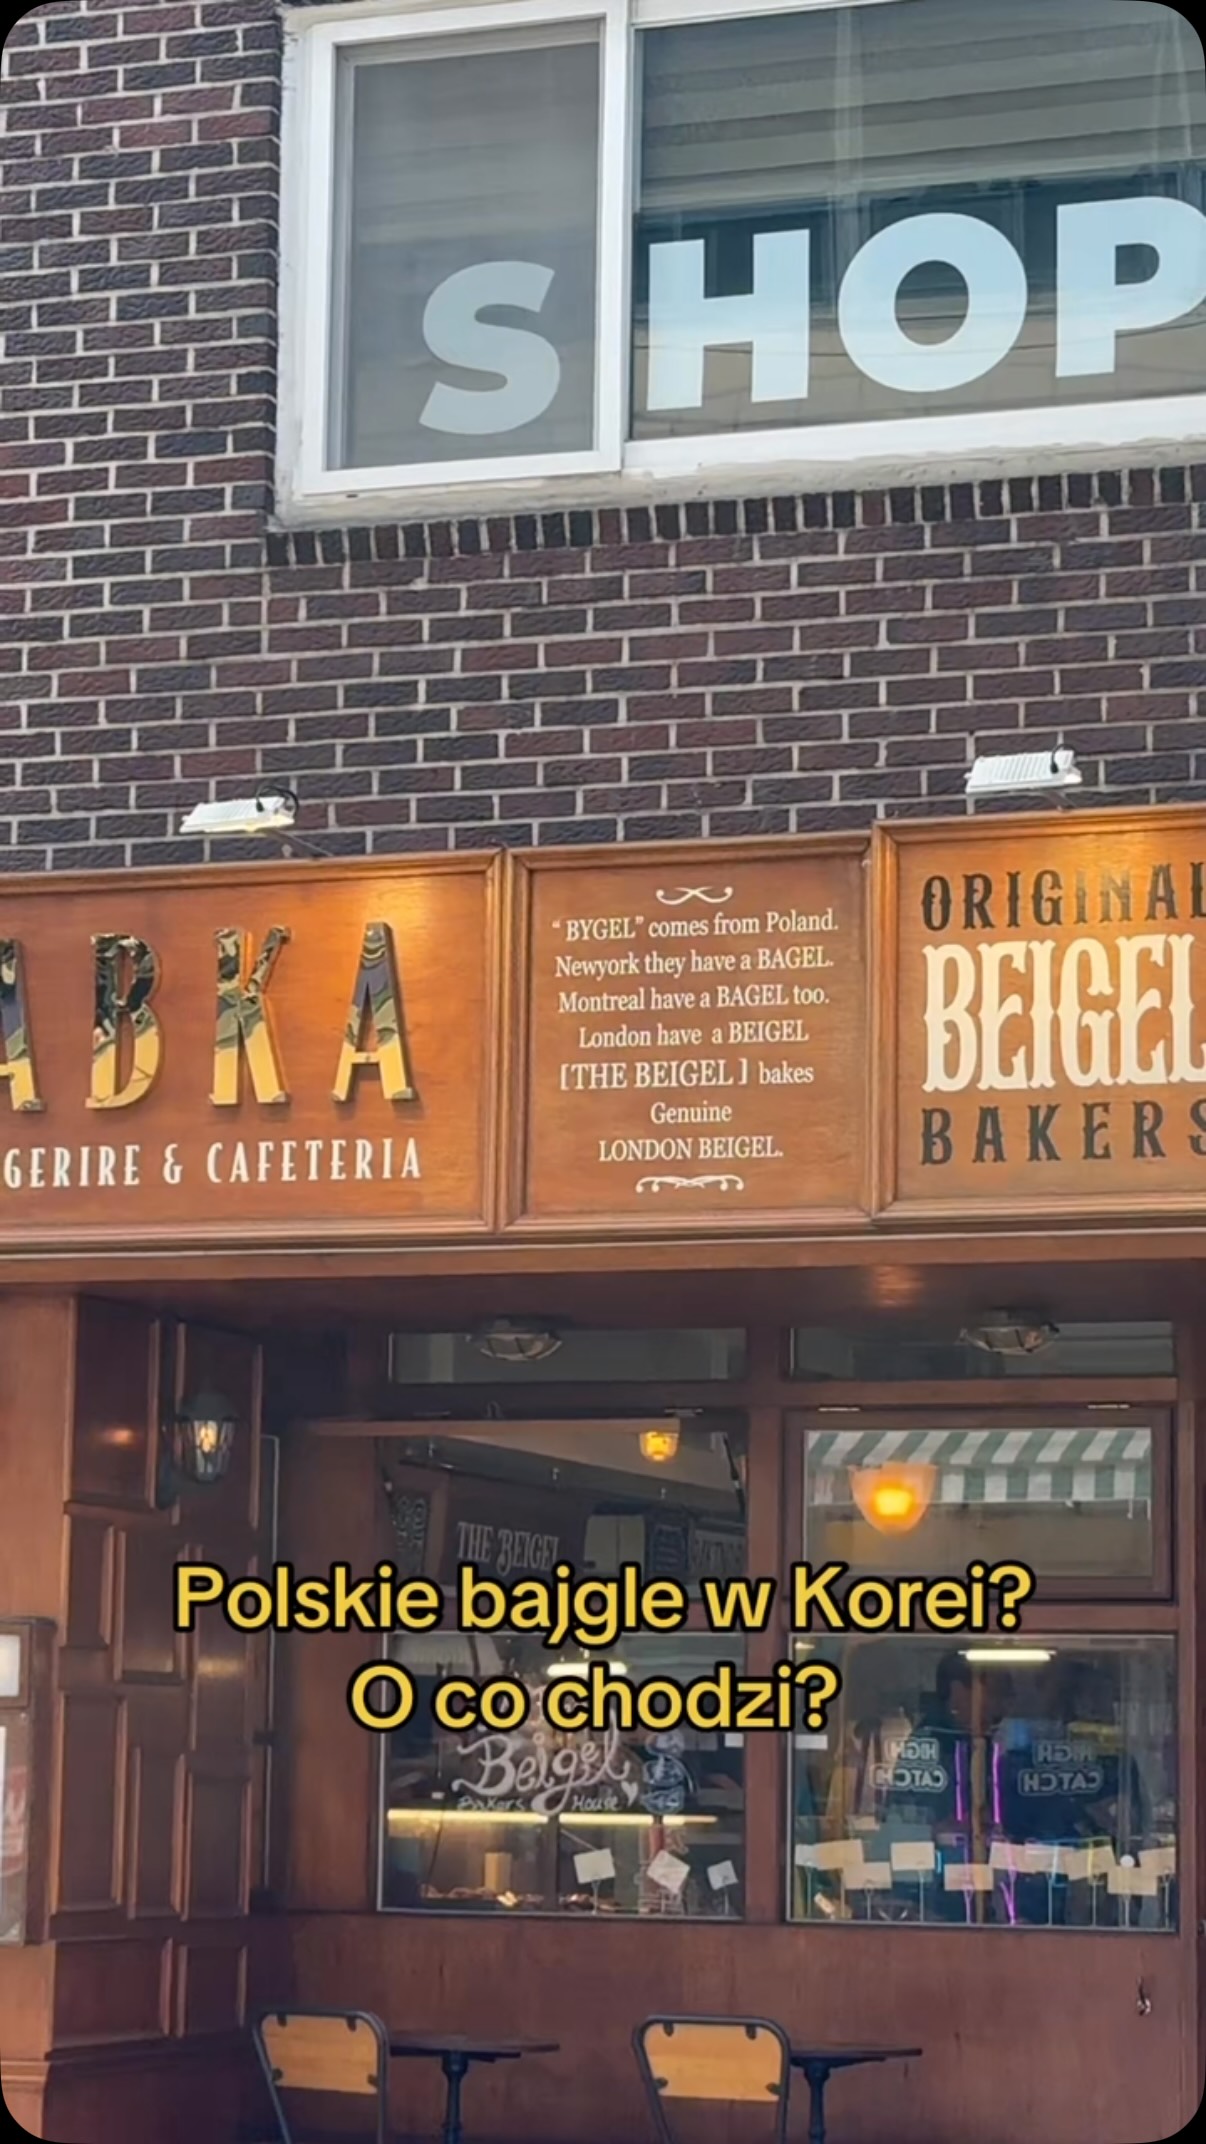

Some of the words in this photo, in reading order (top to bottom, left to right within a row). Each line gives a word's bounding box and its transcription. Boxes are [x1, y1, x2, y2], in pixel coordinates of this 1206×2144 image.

[419, 196, 1206, 435] SHOP
[921, 862, 1206, 931] ORIGINAL
[648, 918, 708, 938] comes
[713, 912, 760, 935] from
[766, 908, 838, 933] Poland.
[555, 953, 639, 981] Newyork
[644, 951, 685, 978] they
[691, 950, 736, 972] have
[740, 953, 751, 970] a
[758, 946, 833, 969] BAGEL.
[558, 988, 645, 1013] Montreal
[651, 988, 695, 1010] have
[700, 991, 711, 1007] a
[716, 985, 788, 1007] BAGEL
[793, 986, 829, 1005] too.
[921, 933, 1206, 1093] BEIGEL
[579, 1025, 650, 1048] London
[657, 1024, 701, 1046] have
[712, 1028, 722, 1043] a
[728, 1020, 809, 1043] BEIGEL
[560, 1063, 627, 1090] [THE
[759, 1061, 814, 1084] bakes
[650, 1101, 731, 1124] Genuine
[599, 1138, 692, 1161] LONDON
[699, 1136, 783, 1158] BEIGEL.
[920, 1099, 1206, 1166] BAKERS
[4, 1144, 141, 1189] GERIRE
[163, 1144, 182, 1183] &
[206, 1138, 421, 1182] CAFETERIA
[451, 1707, 631, 1816] Beigel
